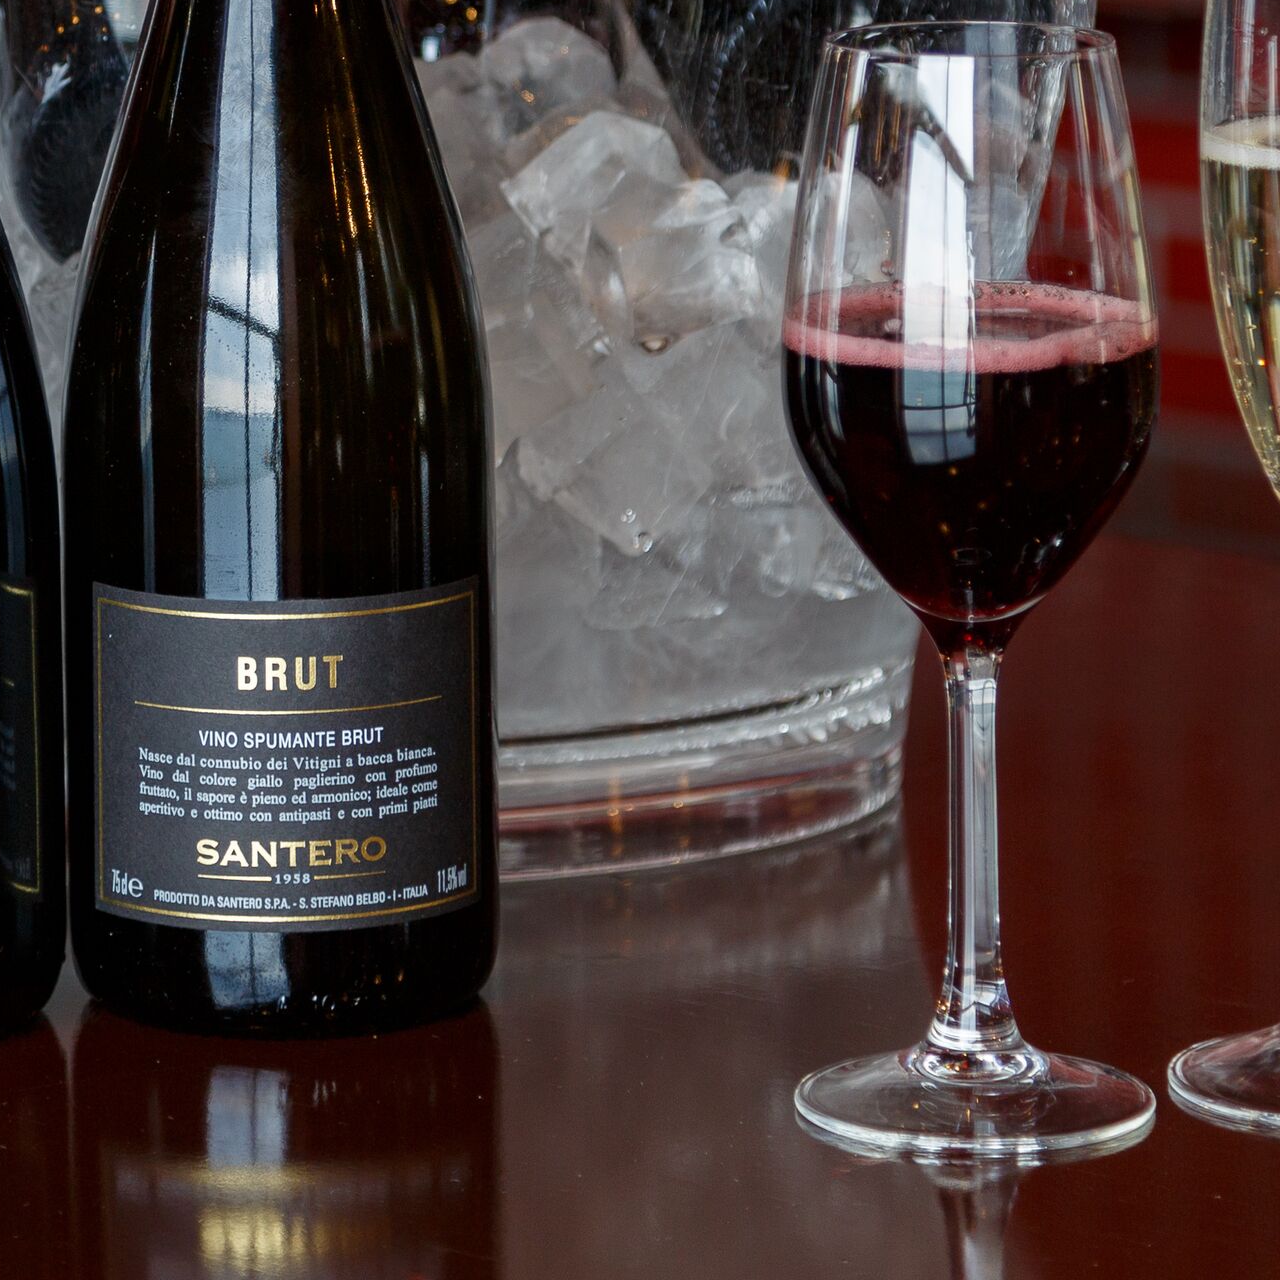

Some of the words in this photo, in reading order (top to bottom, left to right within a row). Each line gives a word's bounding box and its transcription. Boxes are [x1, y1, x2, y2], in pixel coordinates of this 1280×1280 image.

[237, 655, 344, 691] BRUT
[199, 730, 238, 748] VINO
[243, 730, 336, 749] SPUMANTE
[341, 726, 385, 746] BRUT
[139, 747, 173, 764] Nasce
[176, 753, 195, 767] dal
[199, 756, 262, 770] connubio
[266, 757, 288, 770] dei
[293, 755, 341, 772] Vitigni
[346, 757, 354, 767] a
[357, 753, 393, 767] bacca
[396, 746, 436, 762] bianca.
[139, 765, 164, 781] Vino
[172, 770, 190, 783] dal
[199, 773, 237, 787] colore
[247, 775, 283, 790] giallo
[293, 773, 356, 791] paglierino
[365, 771, 387, 783] con
[395, 763, 438, 783] profumo
[139, 782, 180, 801] fruttato,
[184, 787, 192, 801] il
[196, 791, 236, 806] sapore
[239, 791, 248, 805] è
[251, 793, 287, 807] pieno
[291, 791, 307, 805] ed
[311, 789, 372, 804] armonico;
[376, 783, 408, 799] ideale
[412, 779, 438, 793] come
[139, 800, 185, 817] aperitivo
[191, 808, 198, 818] e
[203, 808, 243, 822] ottimo
[249, 811, 272, 822] con
[279, 807, 331, 824] antipasti
[337, 809, 345, 819] e
[351, 806, 373, 819] con
[379, 800, 408, 819] primi
[413, 794, 438, 815] piatti
[196, 835, 387, 868] SANTERO
[274, 873, 311, 885] 1958
[153, 889, 200, 906] PRODOTTO
[201, 894, 215, 907] DA
[217, 895, 262, 909] SANTERO
[264, 898, 291, 910] S.P.A.
[299, 898, 309, 910] S.
[310, 894, 354, 909] STEFANO
[356, 891, 385, 907] BELBO
[403, 884, 428, 900] ITALIA
